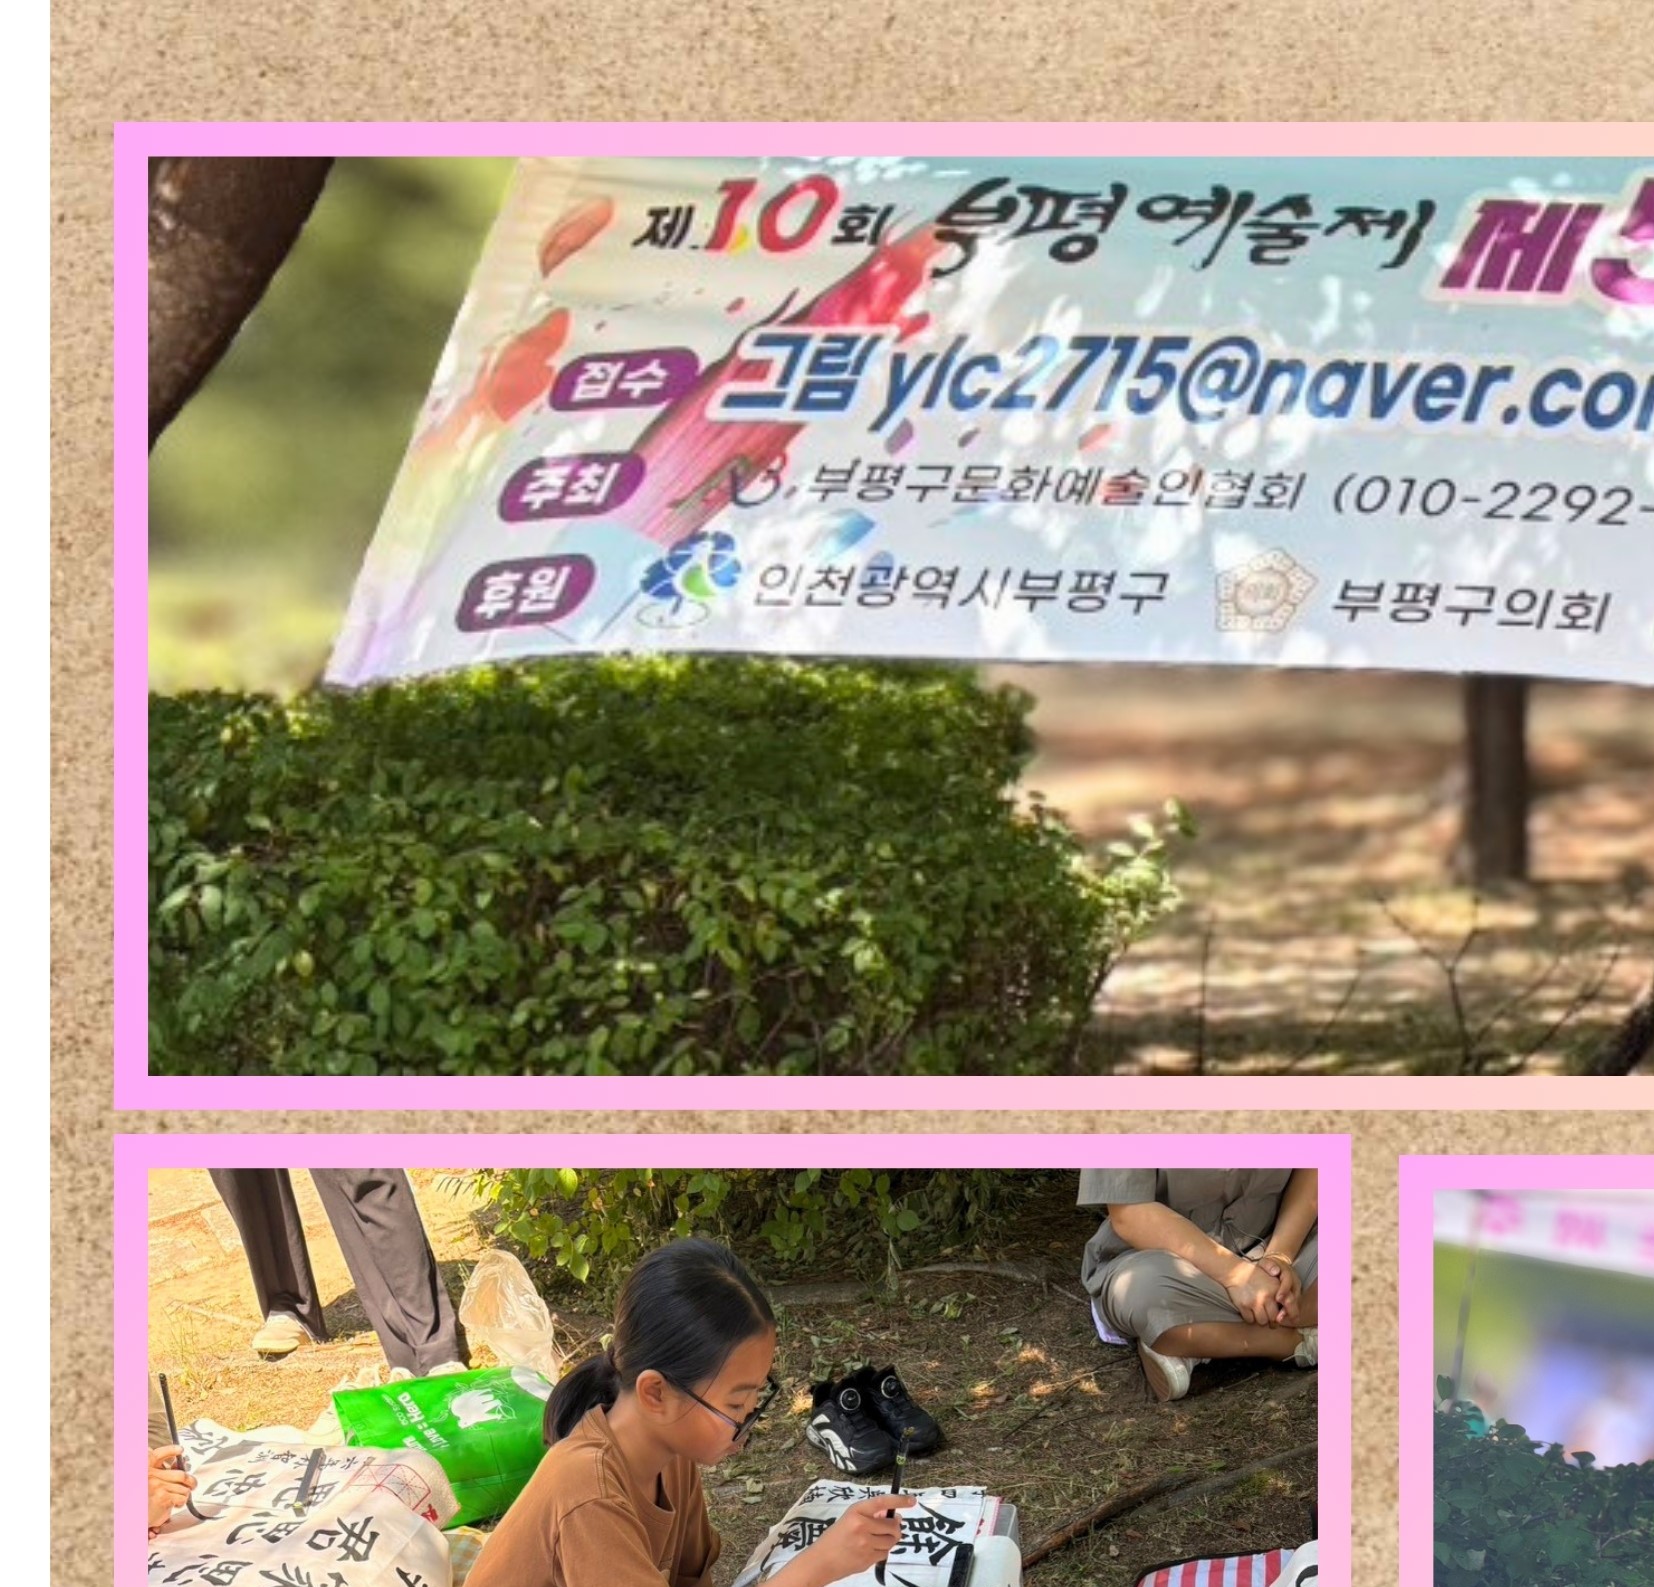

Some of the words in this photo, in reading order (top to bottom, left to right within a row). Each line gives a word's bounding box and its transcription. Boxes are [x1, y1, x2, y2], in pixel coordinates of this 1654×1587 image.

[570, 358, 670, 400] 접수
[720, 331, 884, 412] 그림
[518, 463, 620, 510] 주최
[808, 457, 1306, 512] 부평구문화예술인협회
[475, 563, 570, 619] 후원
[754, 562, 1169, 618] 인천광역시부평구
[1332, 577, 1612, 634] 부평구의회
